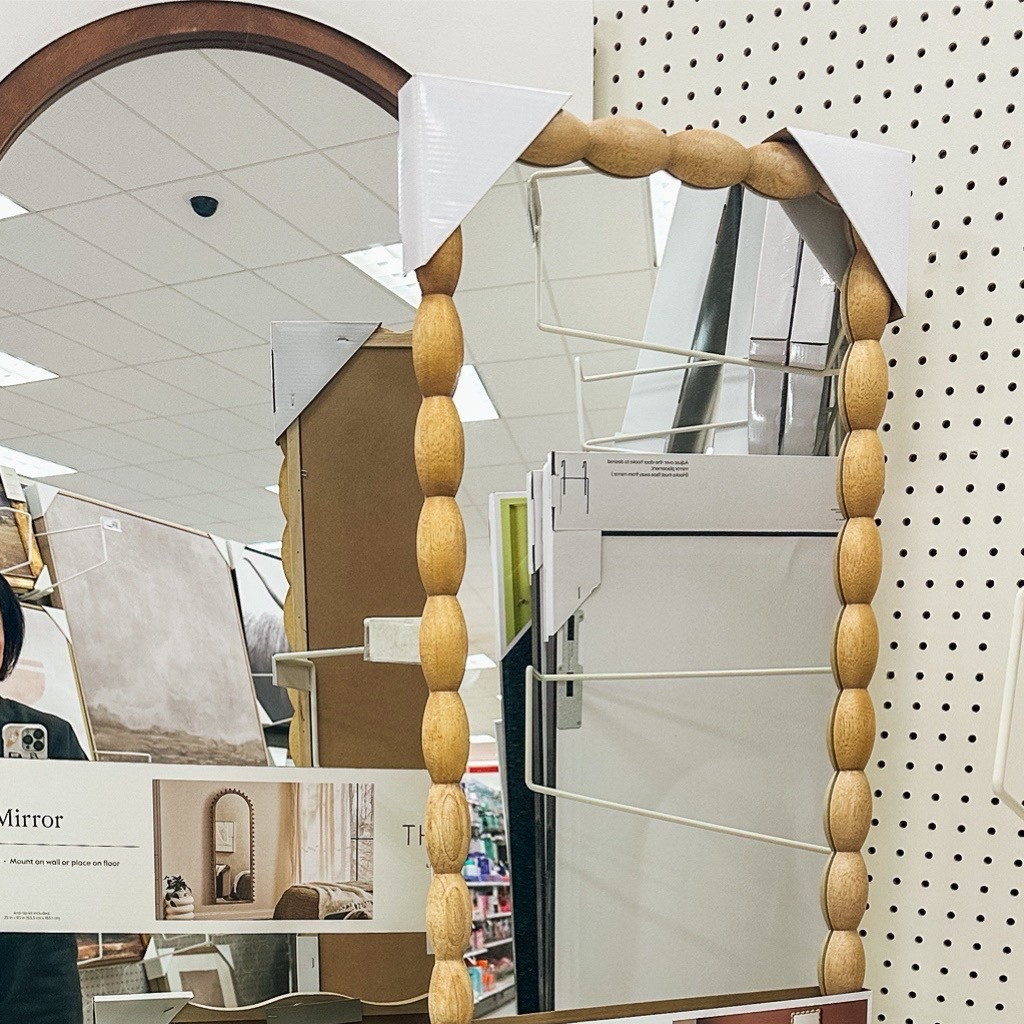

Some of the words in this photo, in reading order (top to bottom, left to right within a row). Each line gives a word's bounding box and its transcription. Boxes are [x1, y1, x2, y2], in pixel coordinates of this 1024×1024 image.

[9, 858, 34, 866] Mount
[46, 858, 61, 866] wall
[71, 859, 91, 867] place
[103, 859, 120, 867] floor
